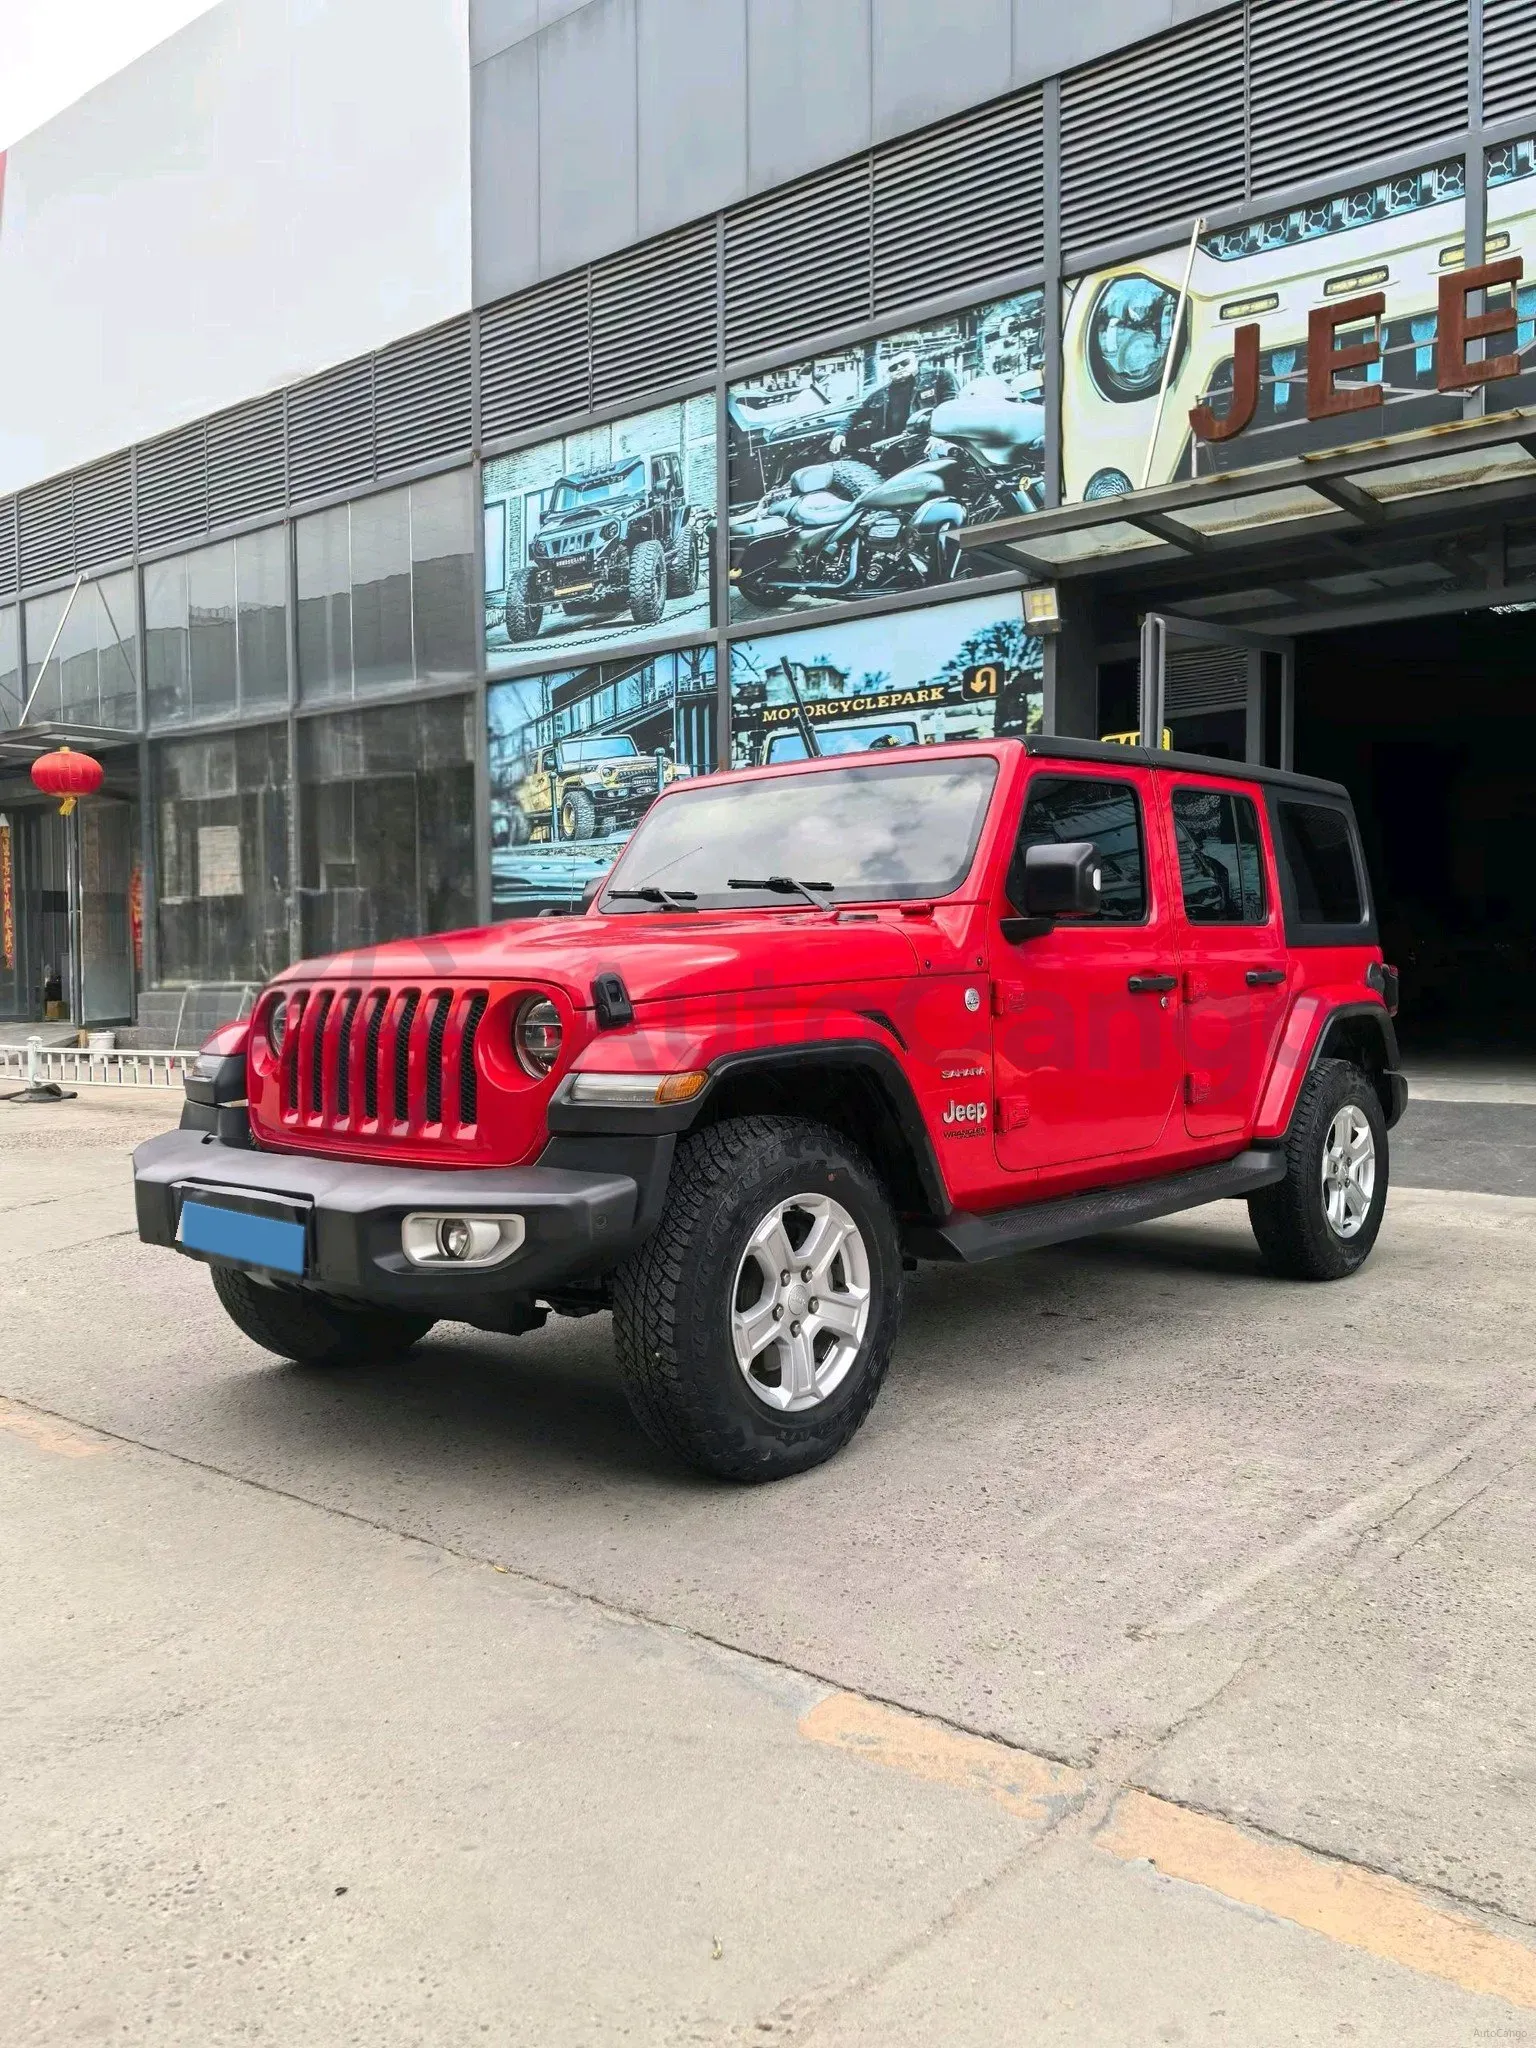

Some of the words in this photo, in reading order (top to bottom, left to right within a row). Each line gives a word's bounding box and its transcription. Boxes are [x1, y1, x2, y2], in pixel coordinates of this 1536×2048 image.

[1188, 256, 1524, 442] JEE
[762, 686, 946, 723] MOTORCYCLEPARK
[941, 1066, 987, 1079] SAHARA
[942, 1099, 988, 1124] Jeep
